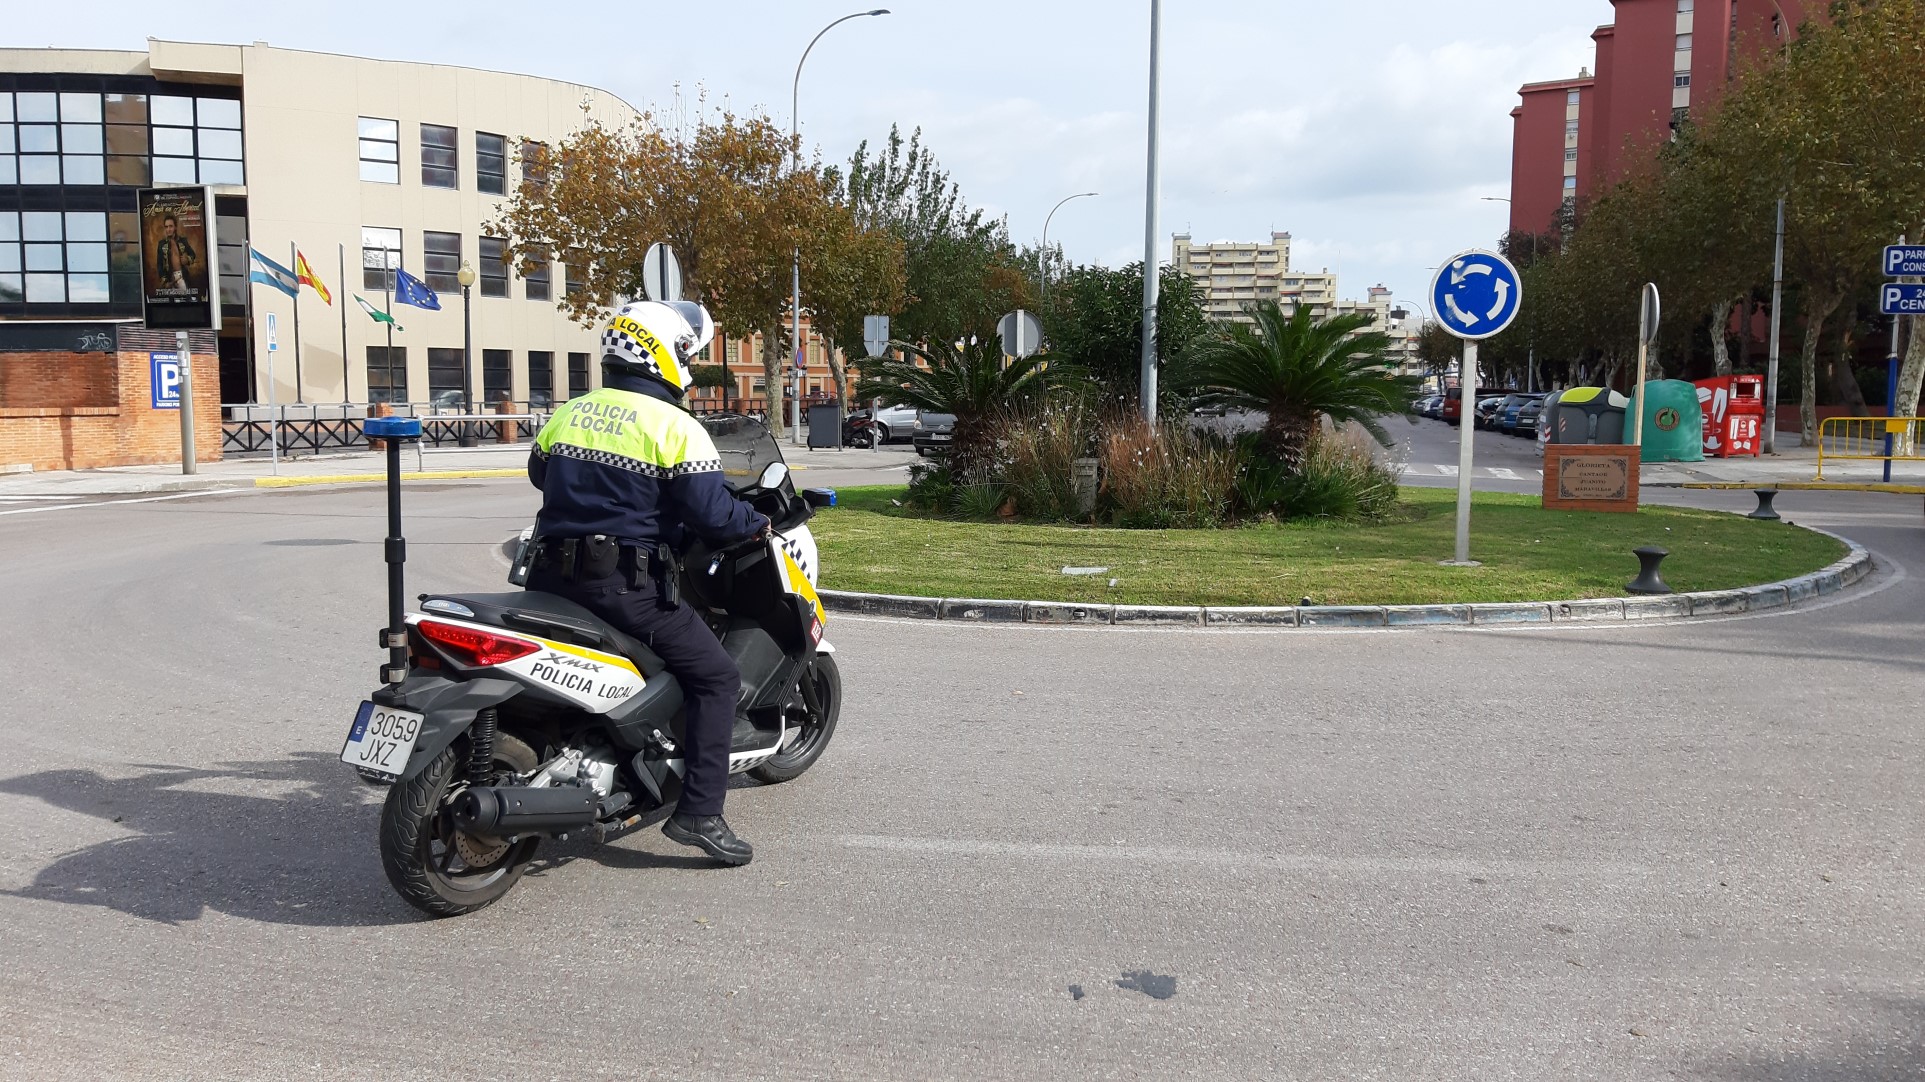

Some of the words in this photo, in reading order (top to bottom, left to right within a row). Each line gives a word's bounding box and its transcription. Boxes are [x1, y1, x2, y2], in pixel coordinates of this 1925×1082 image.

[1889, 250, 1904, 271] P
[1886, 288, 1901, 309] P
[619, 318, 661, 355] LOCAL
[161, 363, 179, 398] P
[570, 414, 624, 436] LOCAL
[571, 402, 638, 424] POLICIA
[530, 662, 594, 694] POLICIA
[597, 683, 634, 699] LOCAL
[355, 725, 363, 735] E
[371, 712, 418, 743] 3059
[359, 738, 397, 767] JXZ
